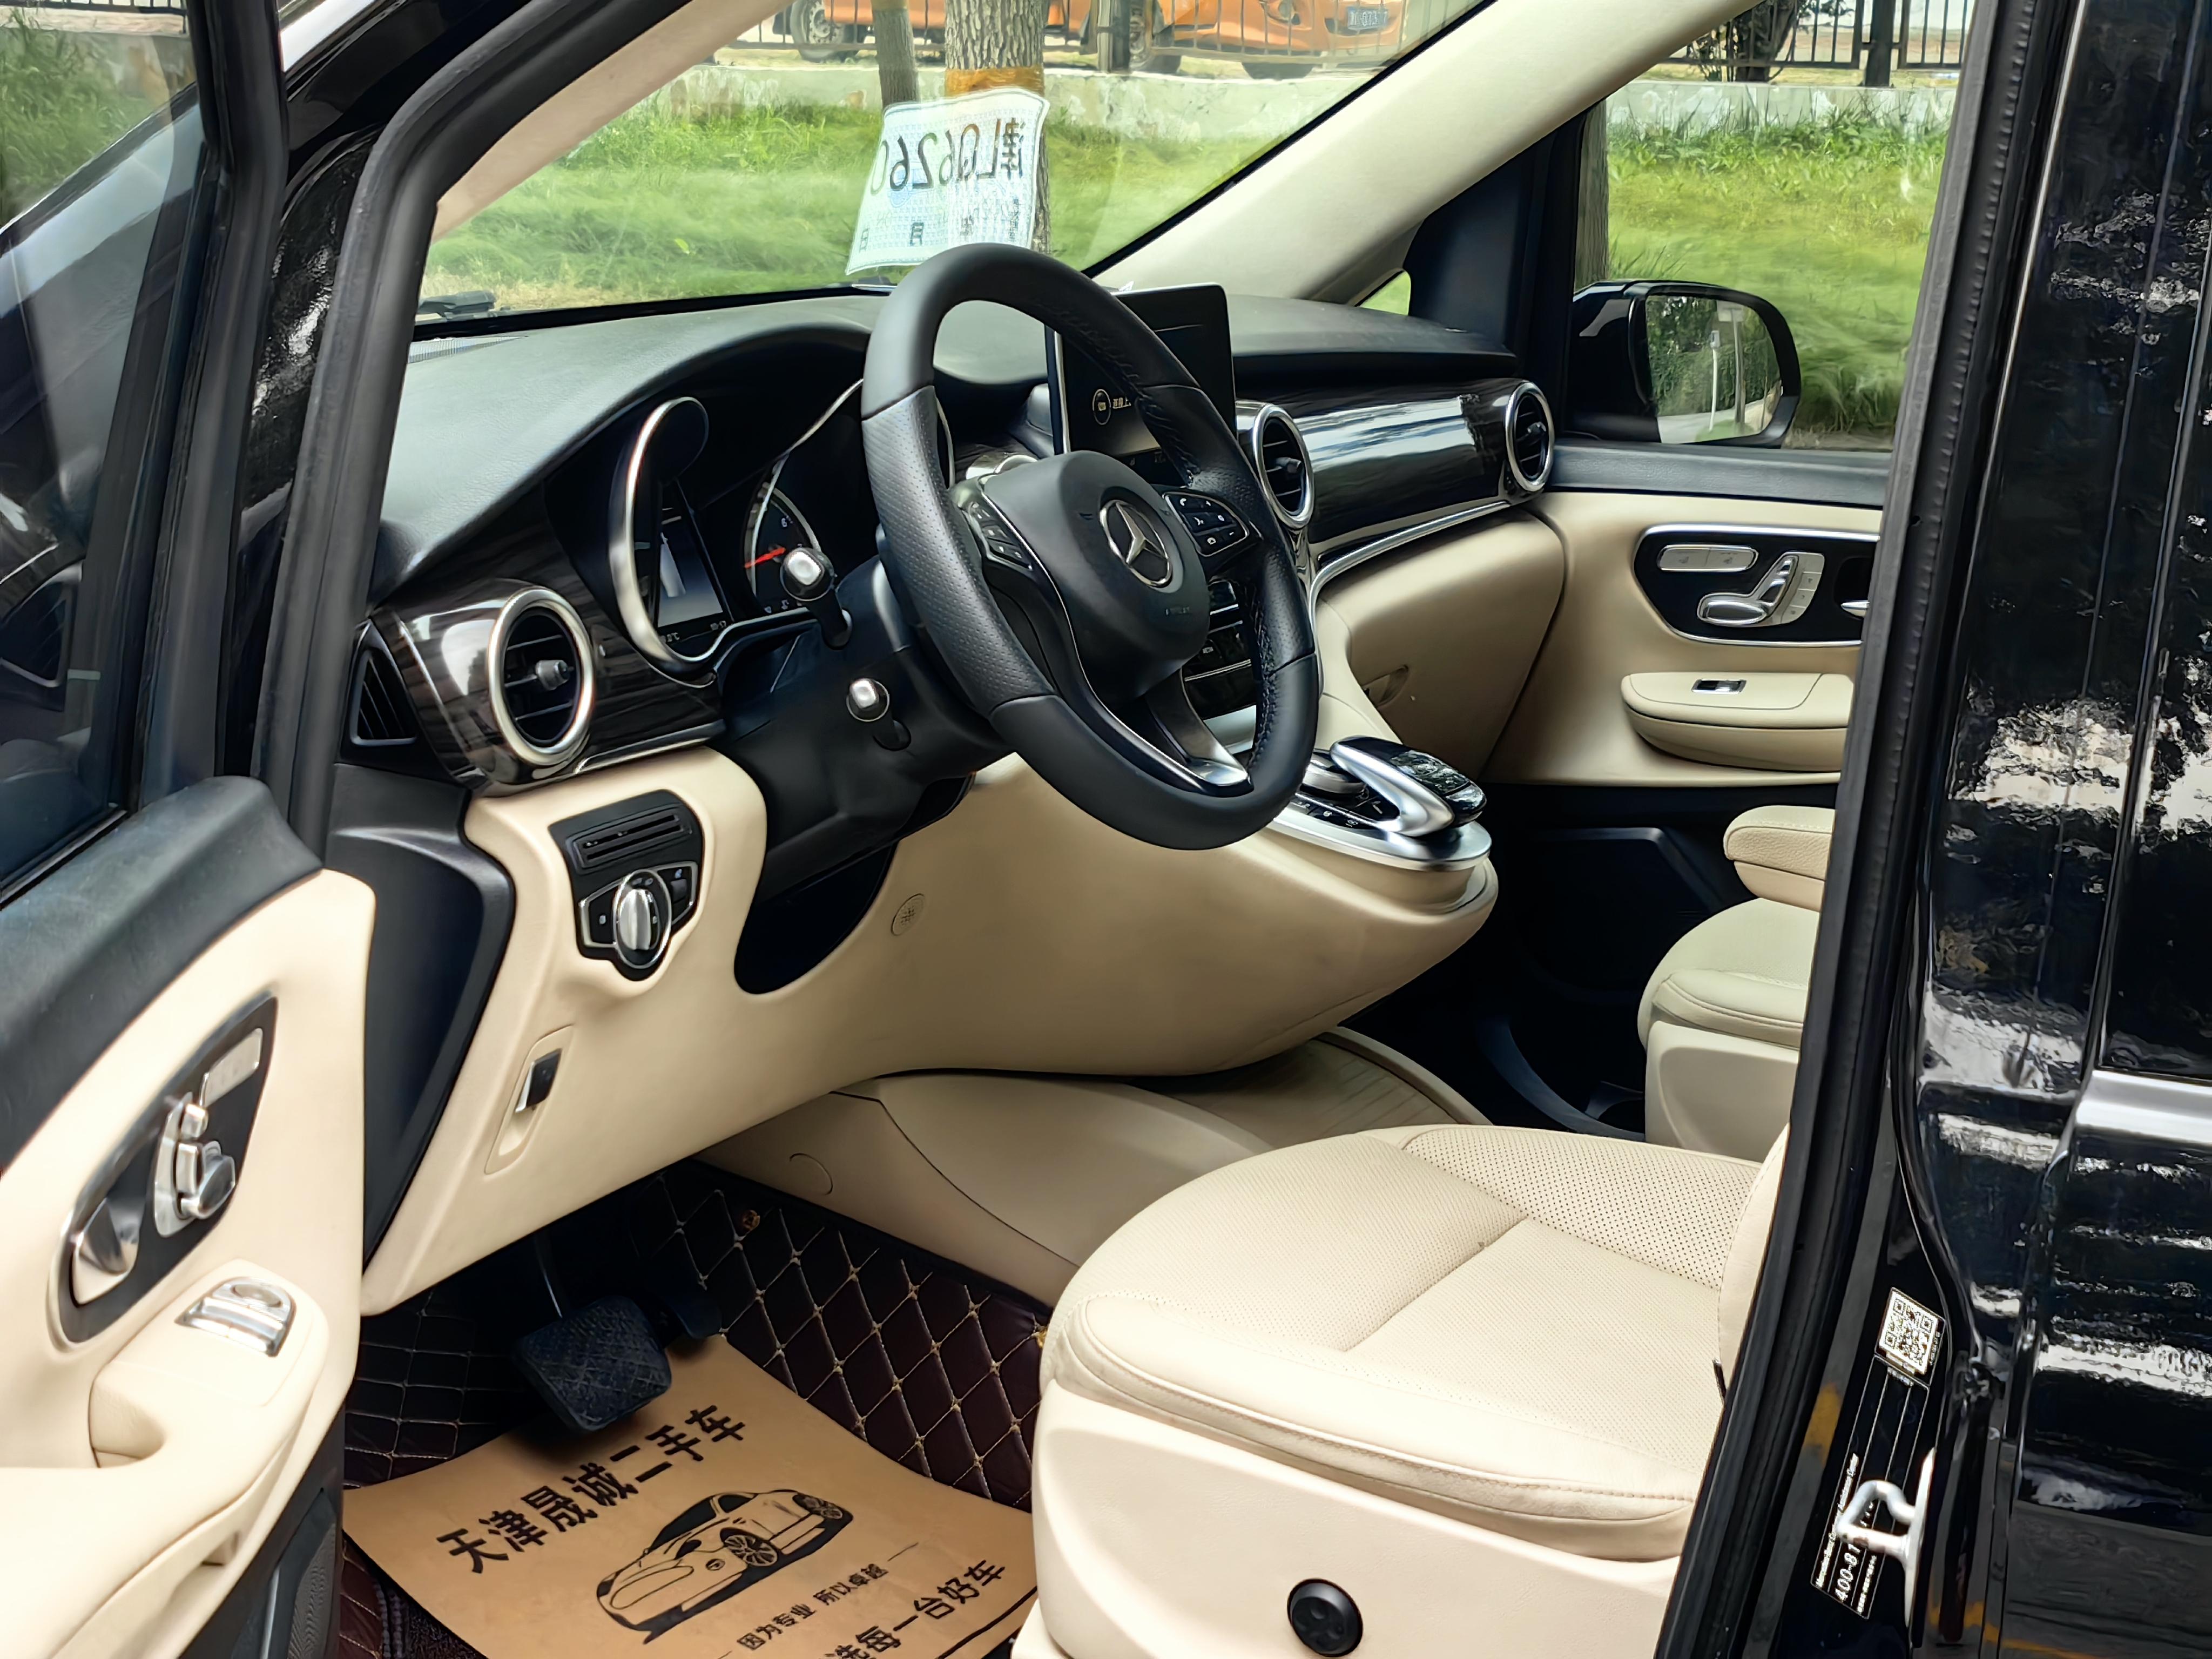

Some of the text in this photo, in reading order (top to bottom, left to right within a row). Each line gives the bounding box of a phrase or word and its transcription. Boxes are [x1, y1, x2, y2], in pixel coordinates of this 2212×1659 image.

[436, 1405, 745, 1574] 天津晟诚二手车
[737, 1603, 817, 1650] 因为专业
